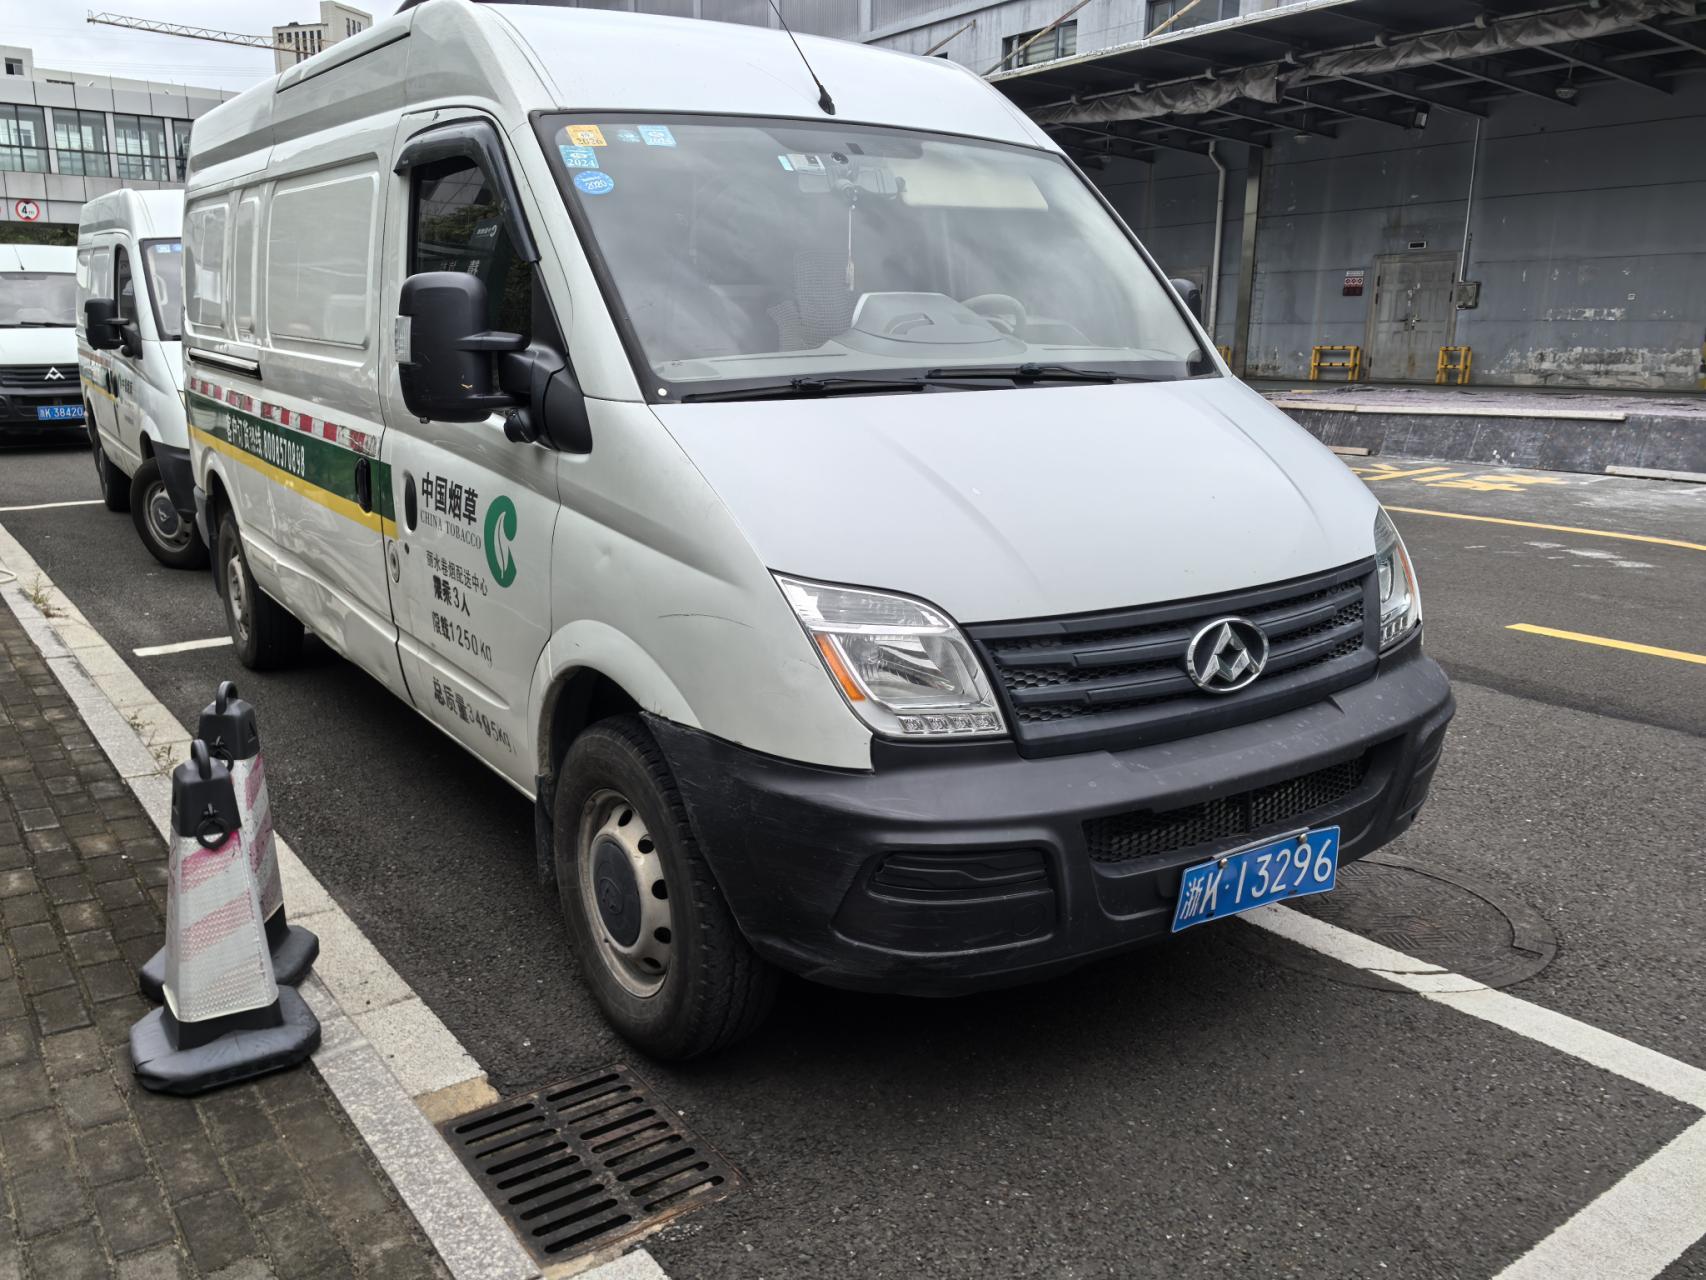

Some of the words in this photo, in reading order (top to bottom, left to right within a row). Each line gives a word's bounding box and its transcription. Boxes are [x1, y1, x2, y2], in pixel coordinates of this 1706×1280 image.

[421, 471, 479, 526] 中国烟草
[420, 510, 443, 531] CHINA
[445, 520, 482, 550] TOBACCO
